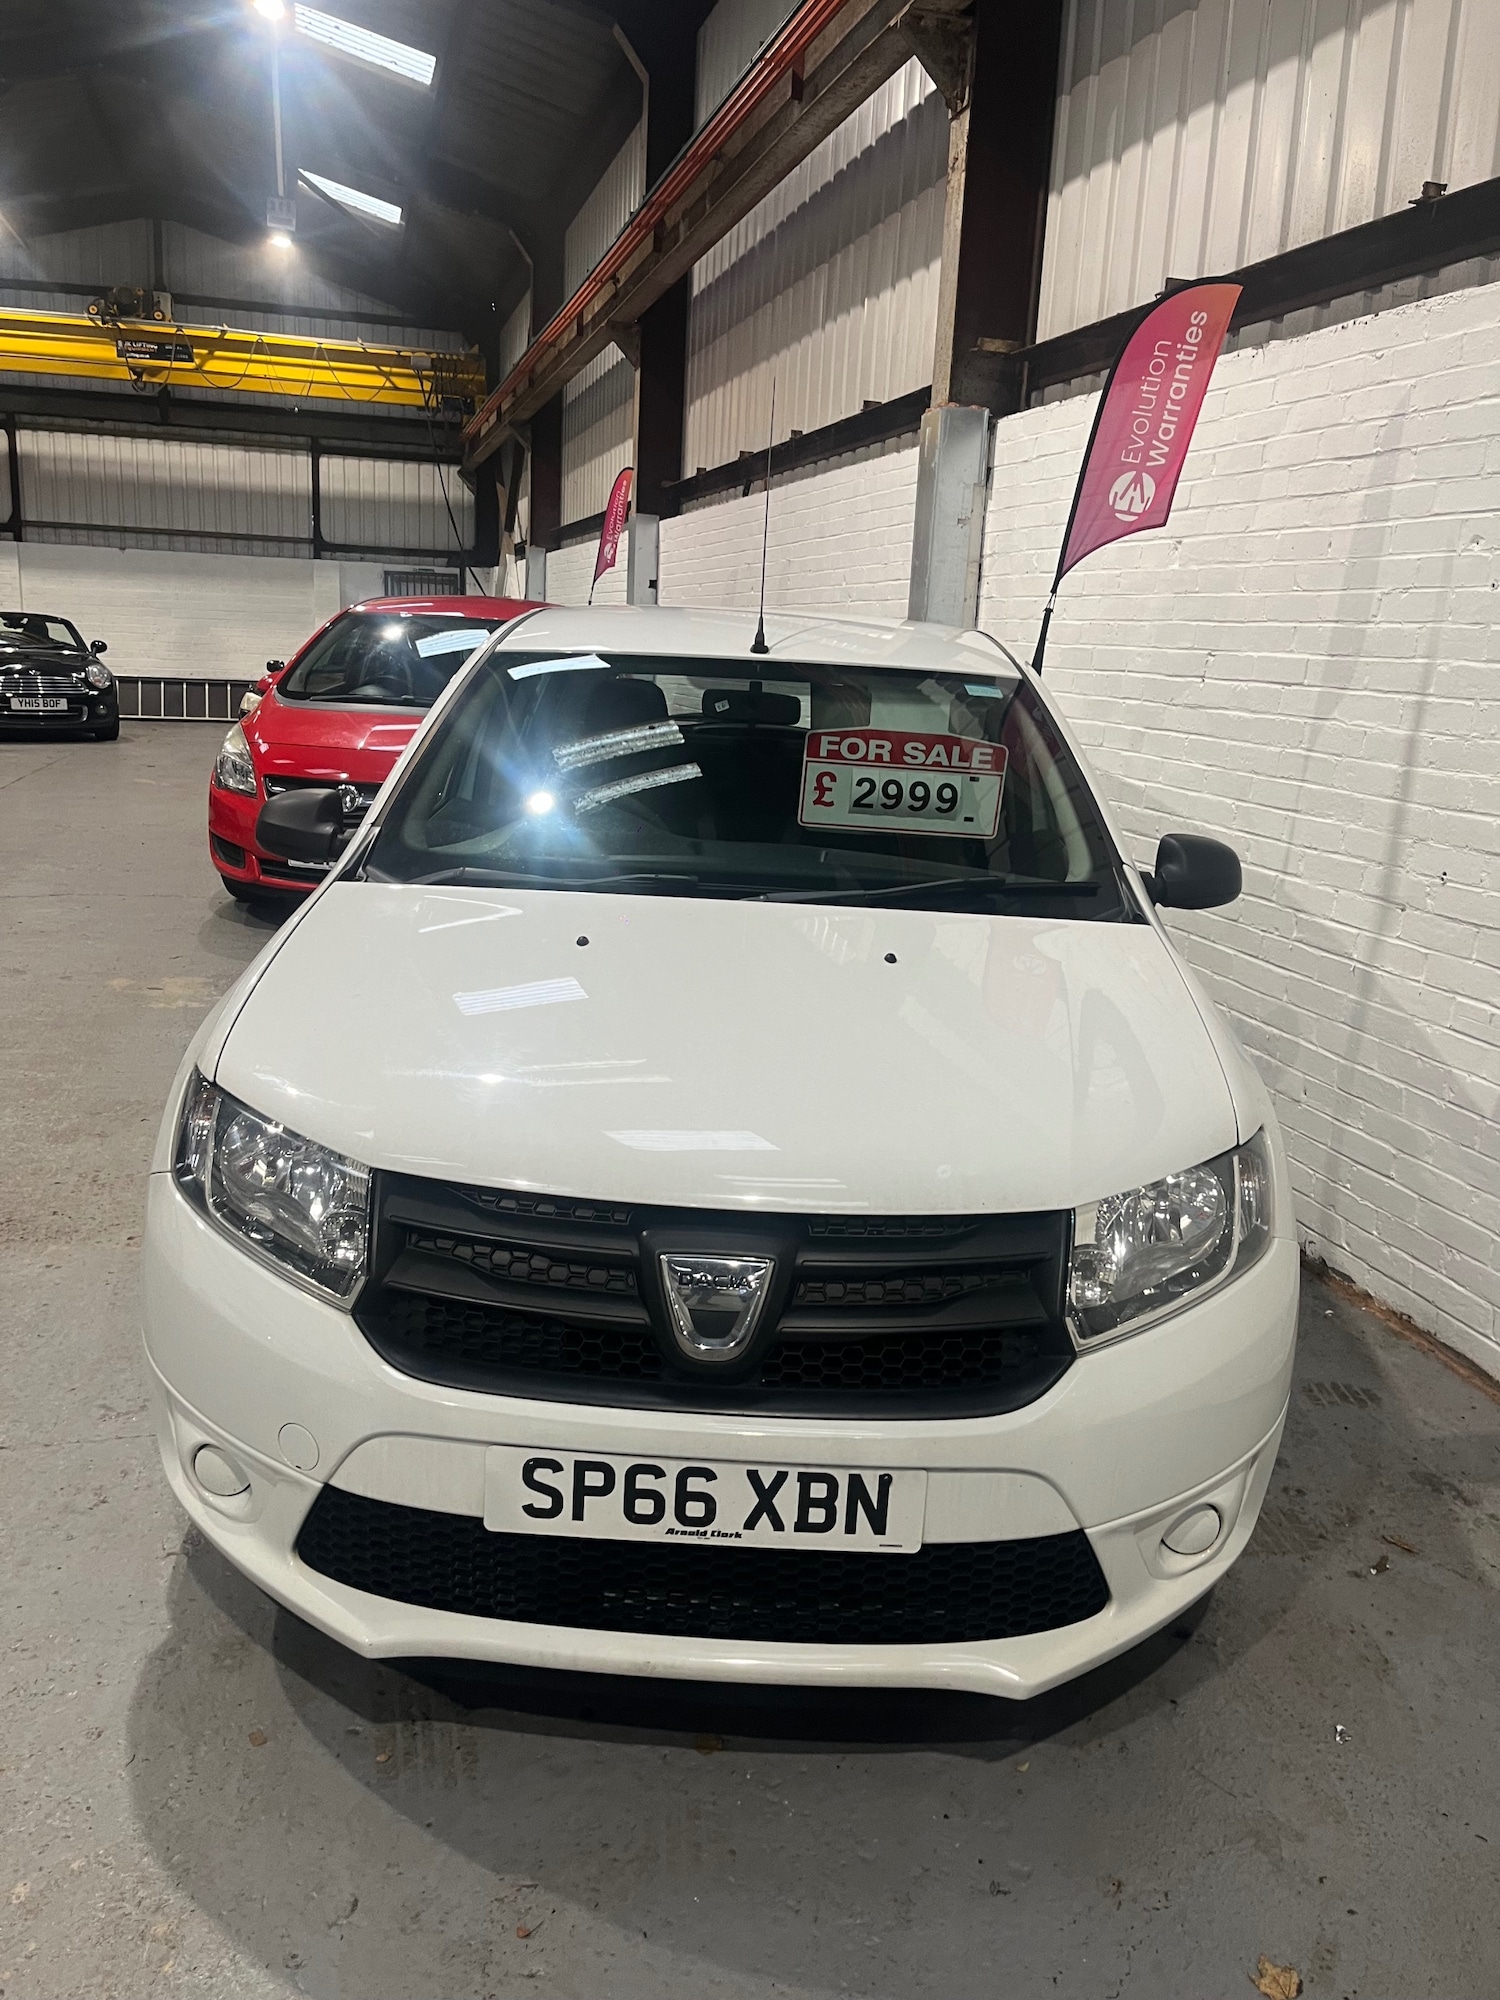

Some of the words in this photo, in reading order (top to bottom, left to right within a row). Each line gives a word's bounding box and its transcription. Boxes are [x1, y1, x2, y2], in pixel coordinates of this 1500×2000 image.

[1121, 340, 1172, 464] Evolution
[1146, 310, 1208, 467] Warranties
[606, 490, 621, 541] Evolution
[17, 698, 41, 708] YH15
[819, 735, 893, 762] FOR
[902, 741, 994, 770] SALE
[813, 771, 838, 807] £
[852, 777, 959, 814] 2999
[521, 1457, 718, 1528] SP66
[743, 1469, 893, 1536] XBN
[664, 1527, 708, 1538] Arnold
[710, 1529, 743, 1539] Clark
